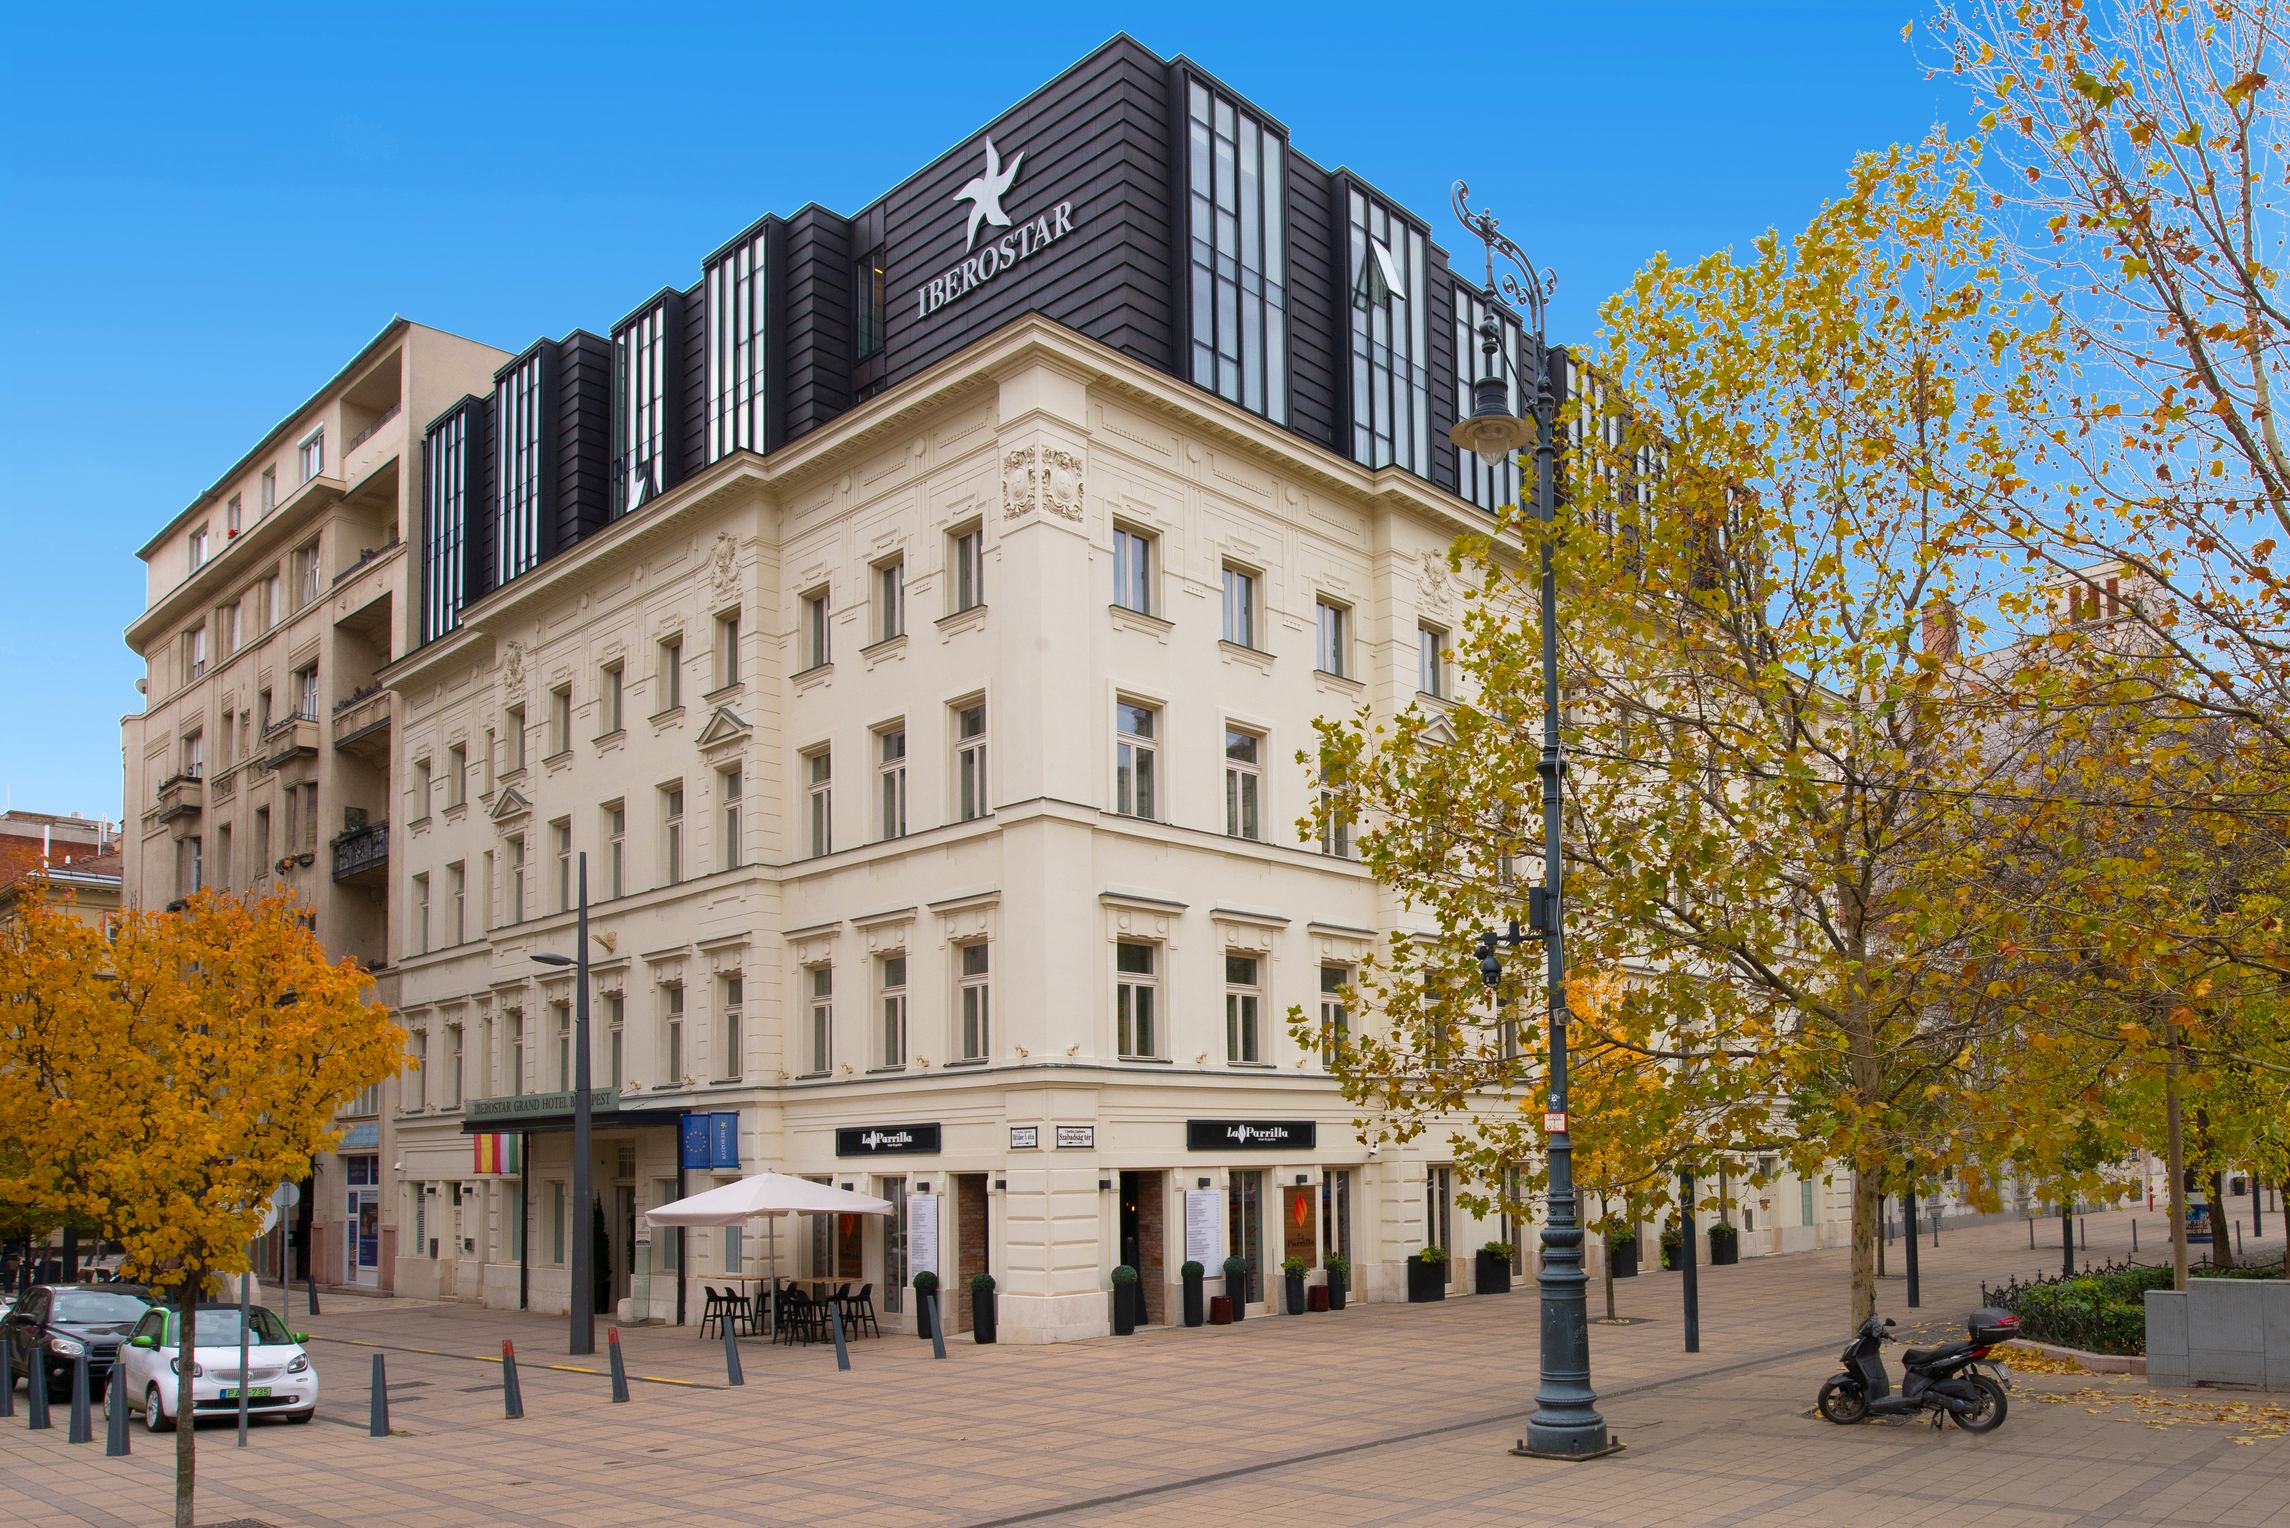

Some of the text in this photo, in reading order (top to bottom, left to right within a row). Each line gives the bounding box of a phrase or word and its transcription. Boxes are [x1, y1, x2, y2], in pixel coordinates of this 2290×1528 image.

[917, 201, 1075, 320] IBEROSTAR
[474, 1092, 611, 1115] IBEROSTAR GRAND HOTEL BPEST
[861, 1131, 913, 1145] La Parrilla
[1059, 1133, 1083, 1141] Szabadság
[1226, 1126, 1288, 1138] La Parrilla
[228, 1388, 268, 1397] PA-735
